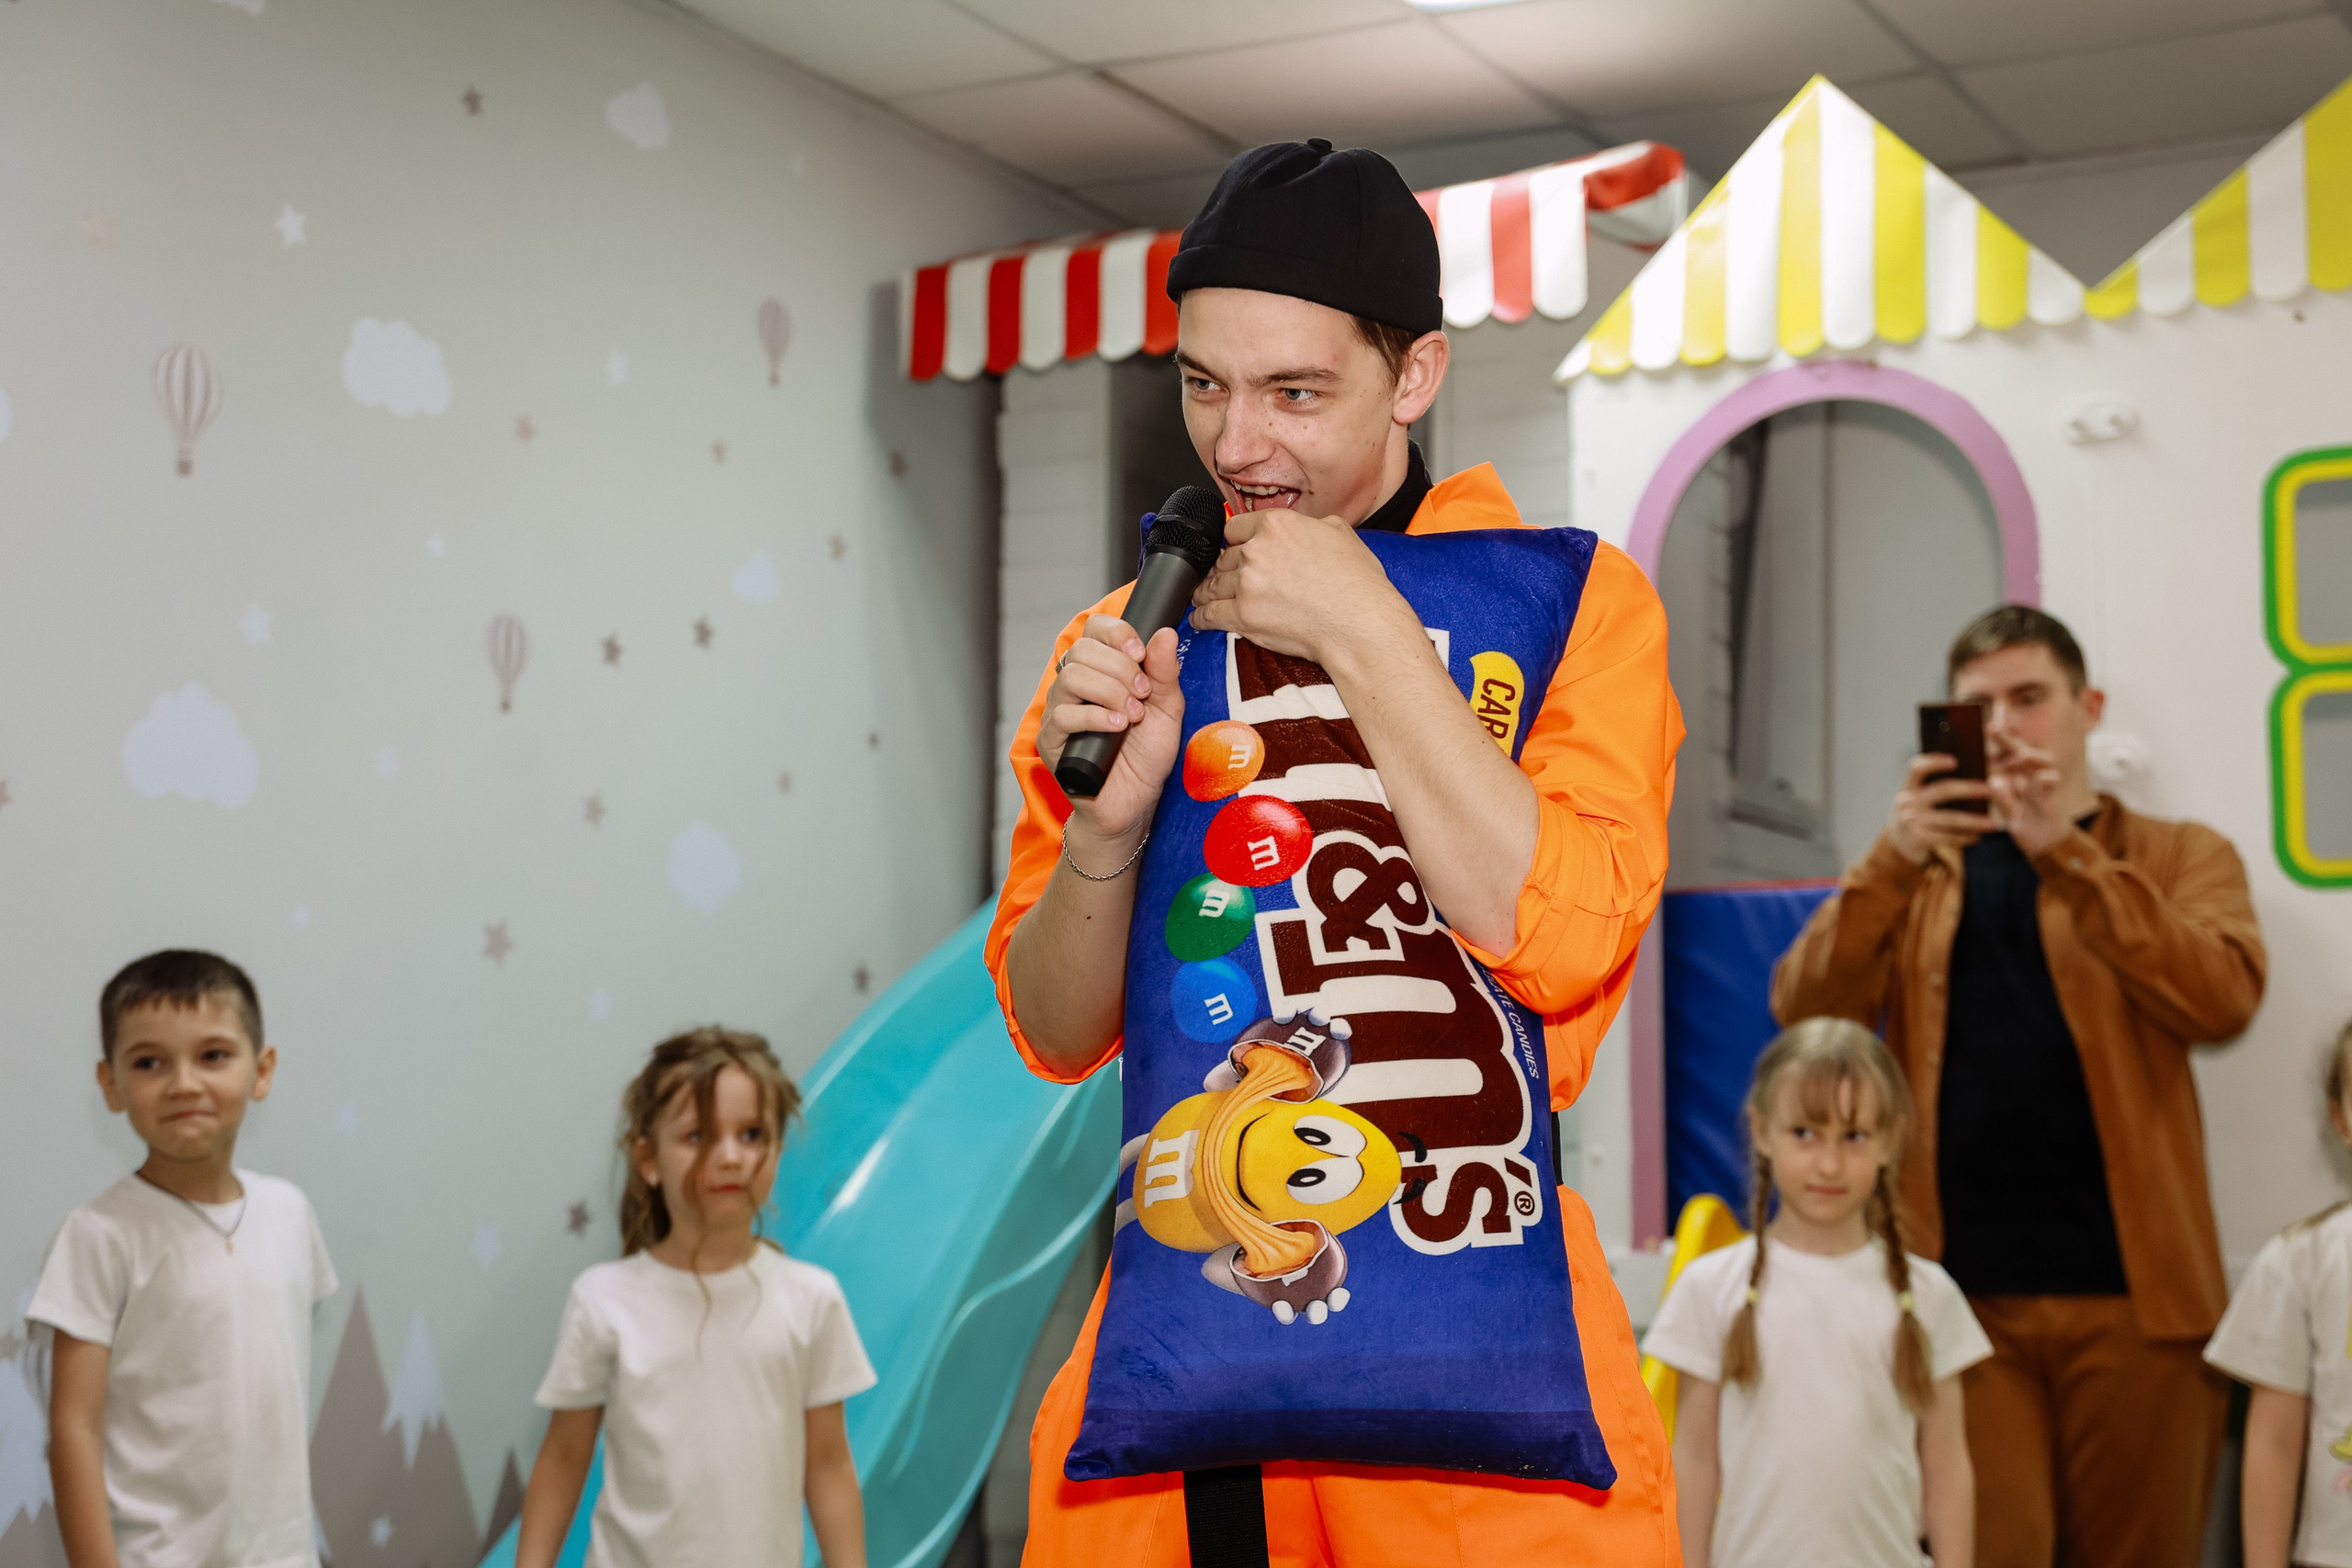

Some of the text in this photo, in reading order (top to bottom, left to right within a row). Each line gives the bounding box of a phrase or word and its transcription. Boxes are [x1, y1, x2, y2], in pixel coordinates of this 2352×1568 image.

[1227, 744, 1251, 770] m
[1247, 835, 1281, 871] m
[1198, 888, 1230, 919] m
[1204, 993, 1234, 1026] m
[1508, 1011, 1540, 1079] CANDIES
